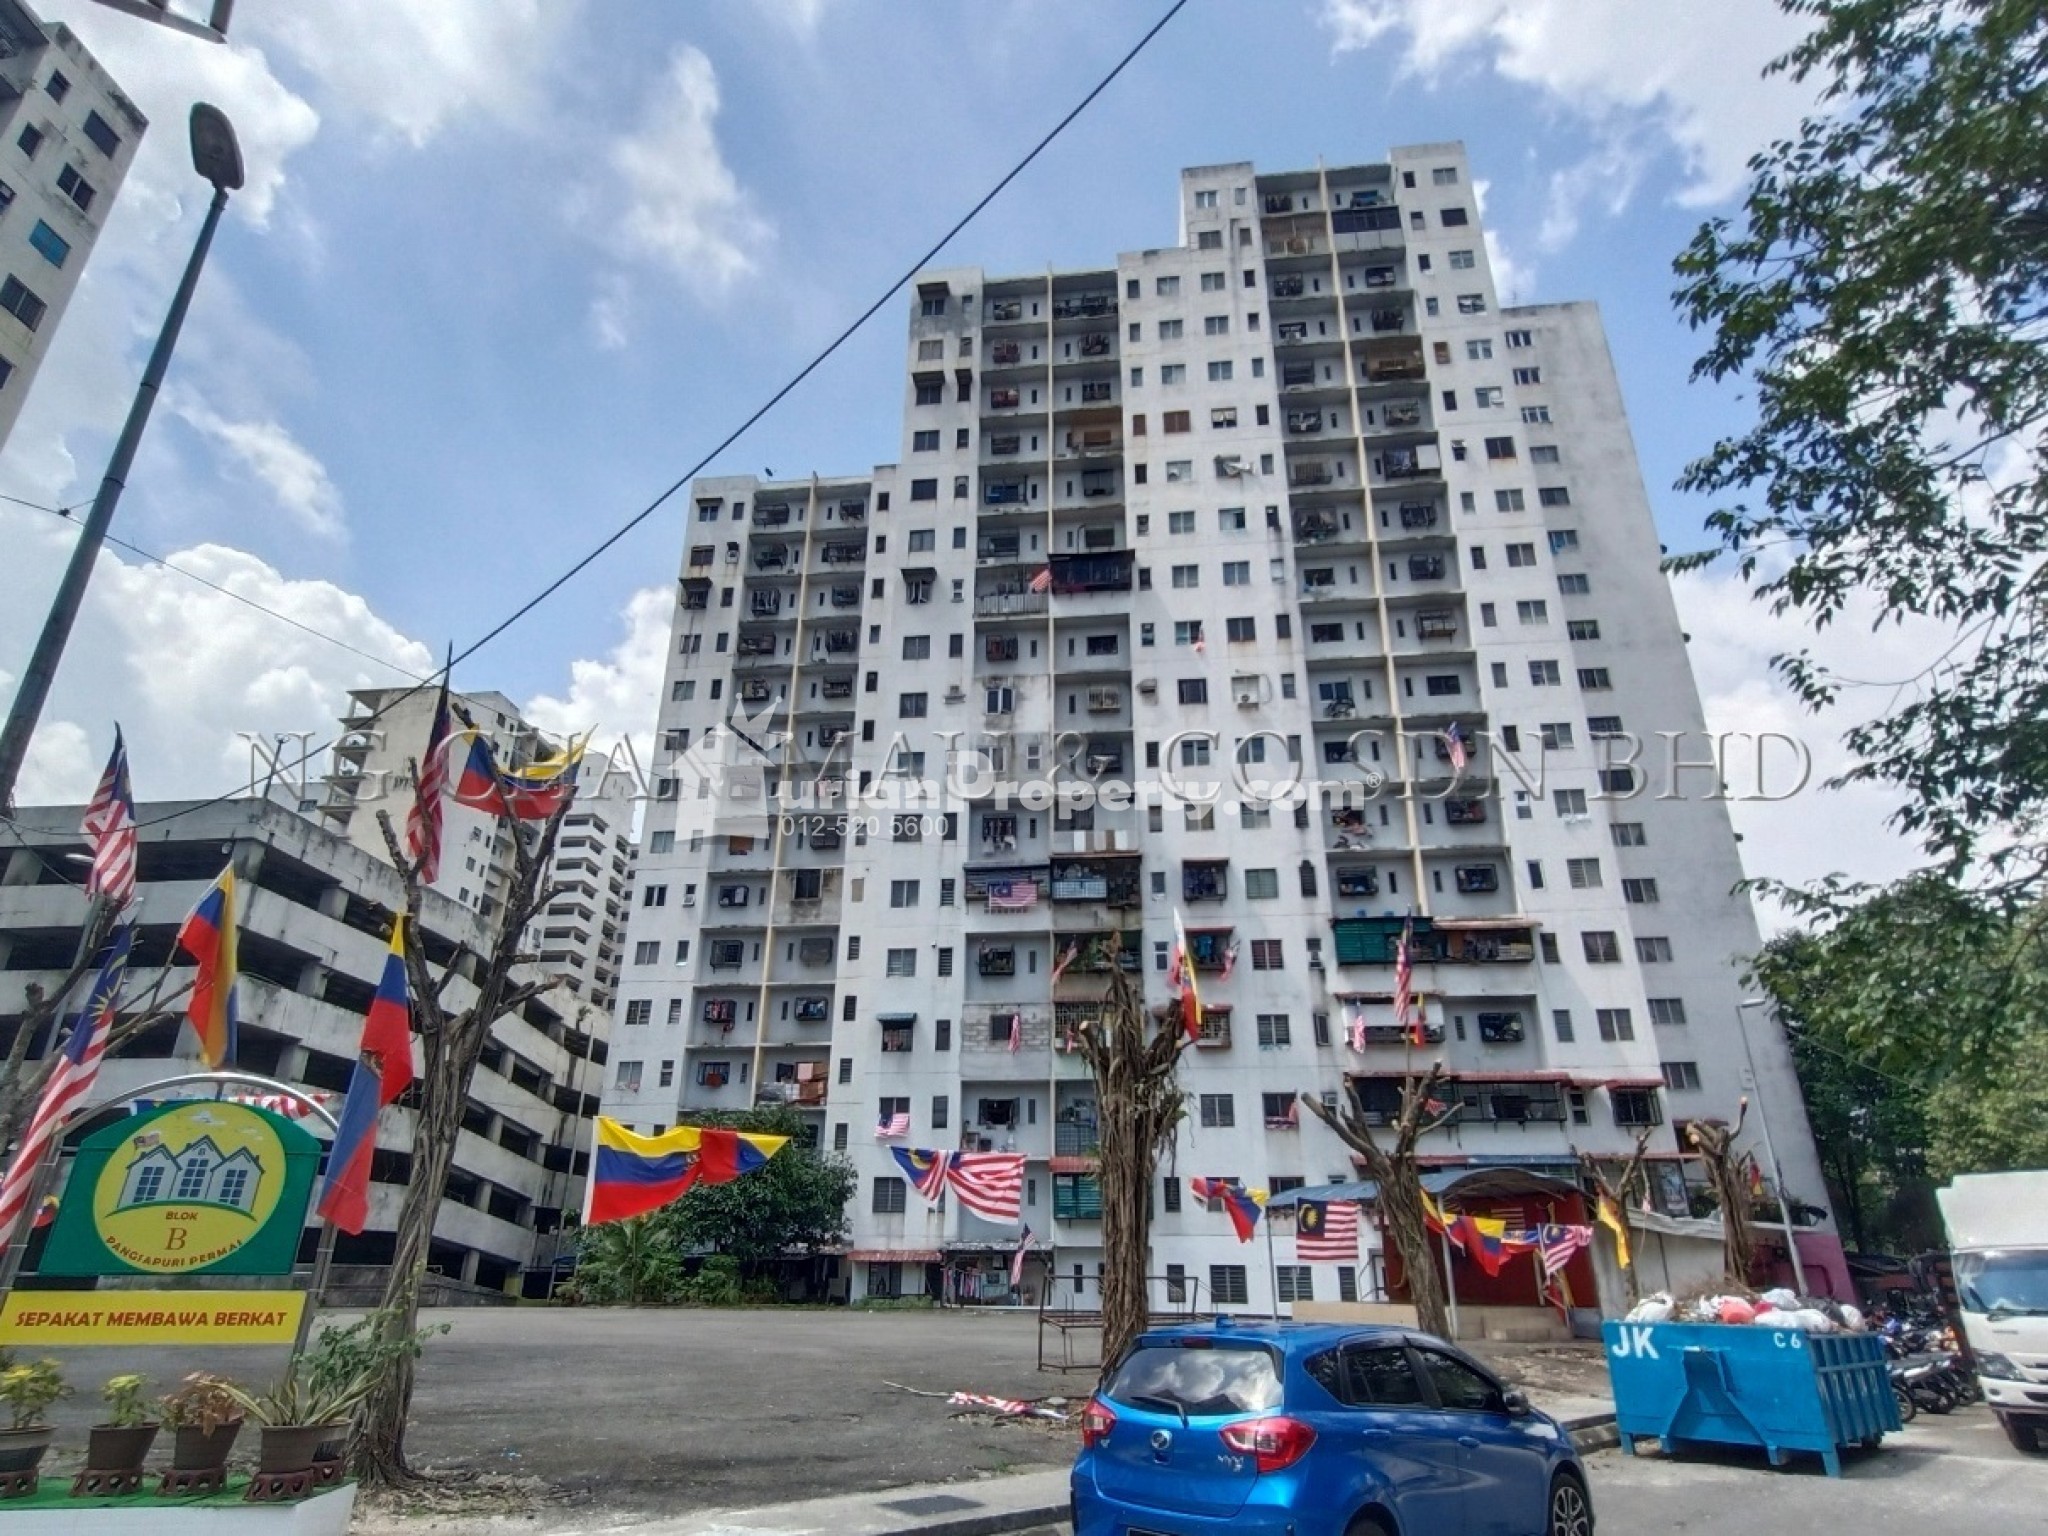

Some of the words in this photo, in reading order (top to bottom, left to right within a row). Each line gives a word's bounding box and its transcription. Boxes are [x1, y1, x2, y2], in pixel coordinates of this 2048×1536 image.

[165, 1210, 199, 1221] BLOK
[164, 1227, 188, 1251] B
[106, 1235, 185, 1268] PANGSAPURI
[189, 1239, 243, 1266] PERMAI
[15, 1311, 104, 1327] SEPAKAT
[106, 1311, 209, 1327] MEMBAWA
[213, 1311, 288, 1327] BERKAT
[1611, 1325, 1659, 1360] JK
